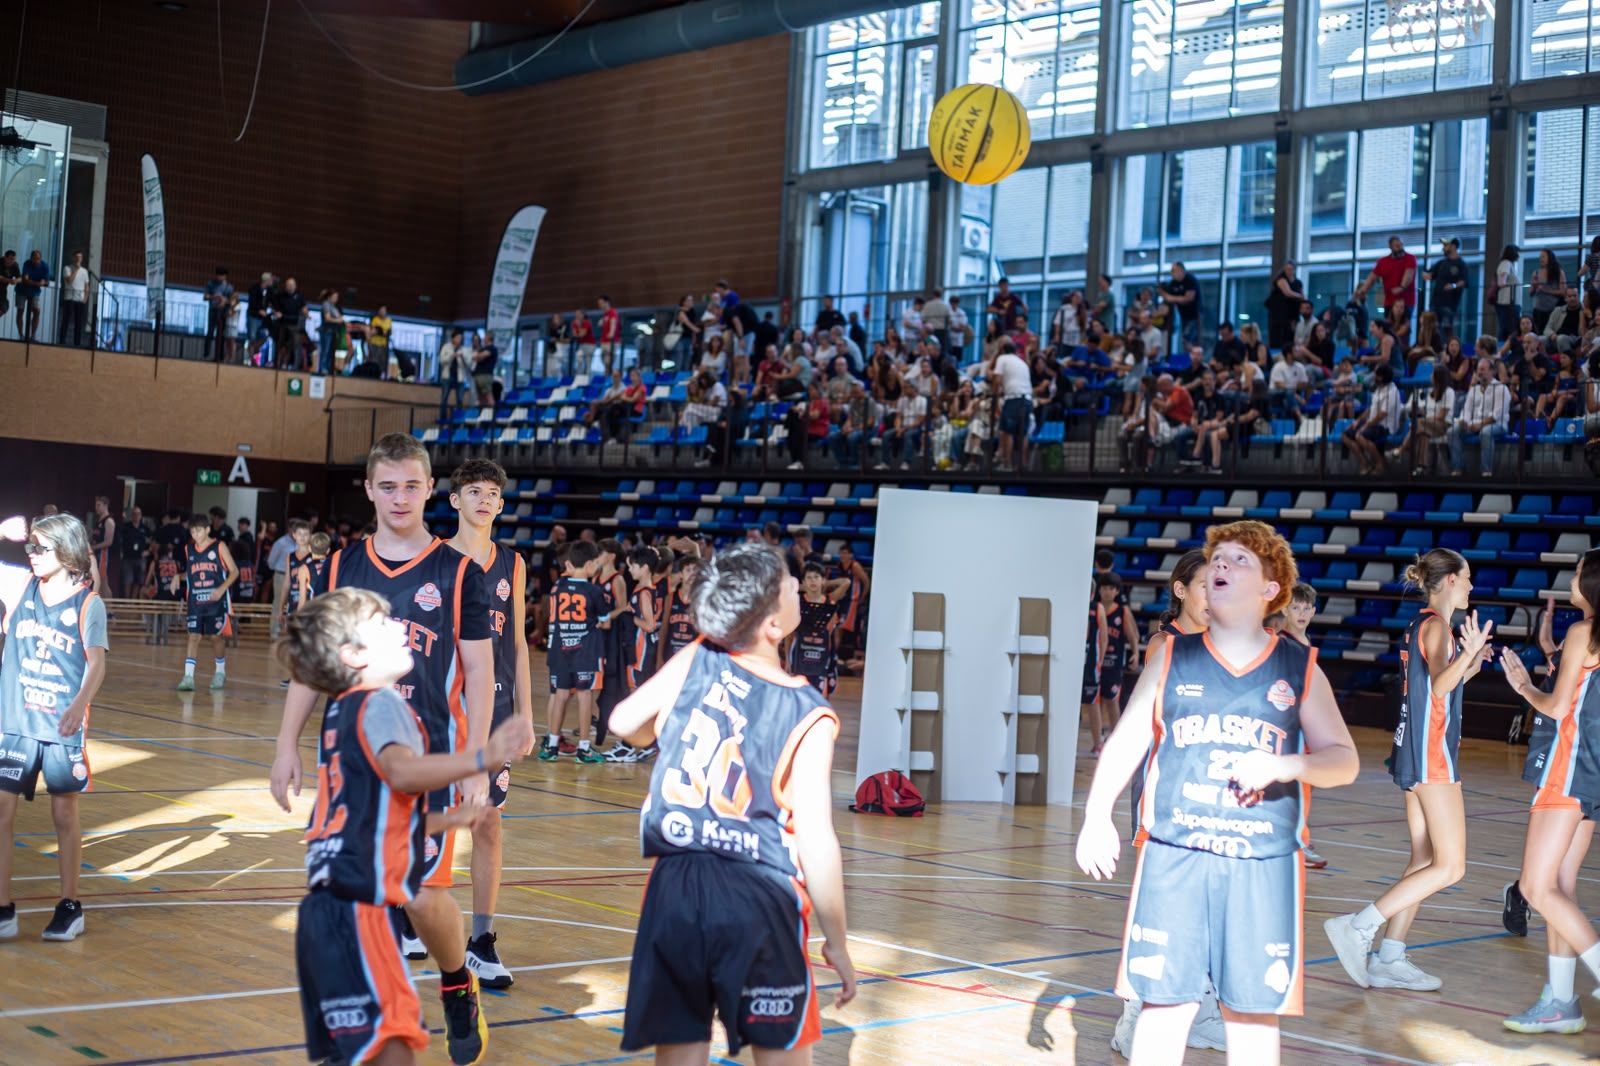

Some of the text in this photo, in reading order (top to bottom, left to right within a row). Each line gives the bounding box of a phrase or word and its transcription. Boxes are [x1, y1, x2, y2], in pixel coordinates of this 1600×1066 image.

[952, 105, 983, 169] TARMAK
[227, 455, 251, 483] A
[558, 592, 587, 622] 23
[661, 707, 753, 822] 30
[1172, 807, 1273, 837] Superwagen
